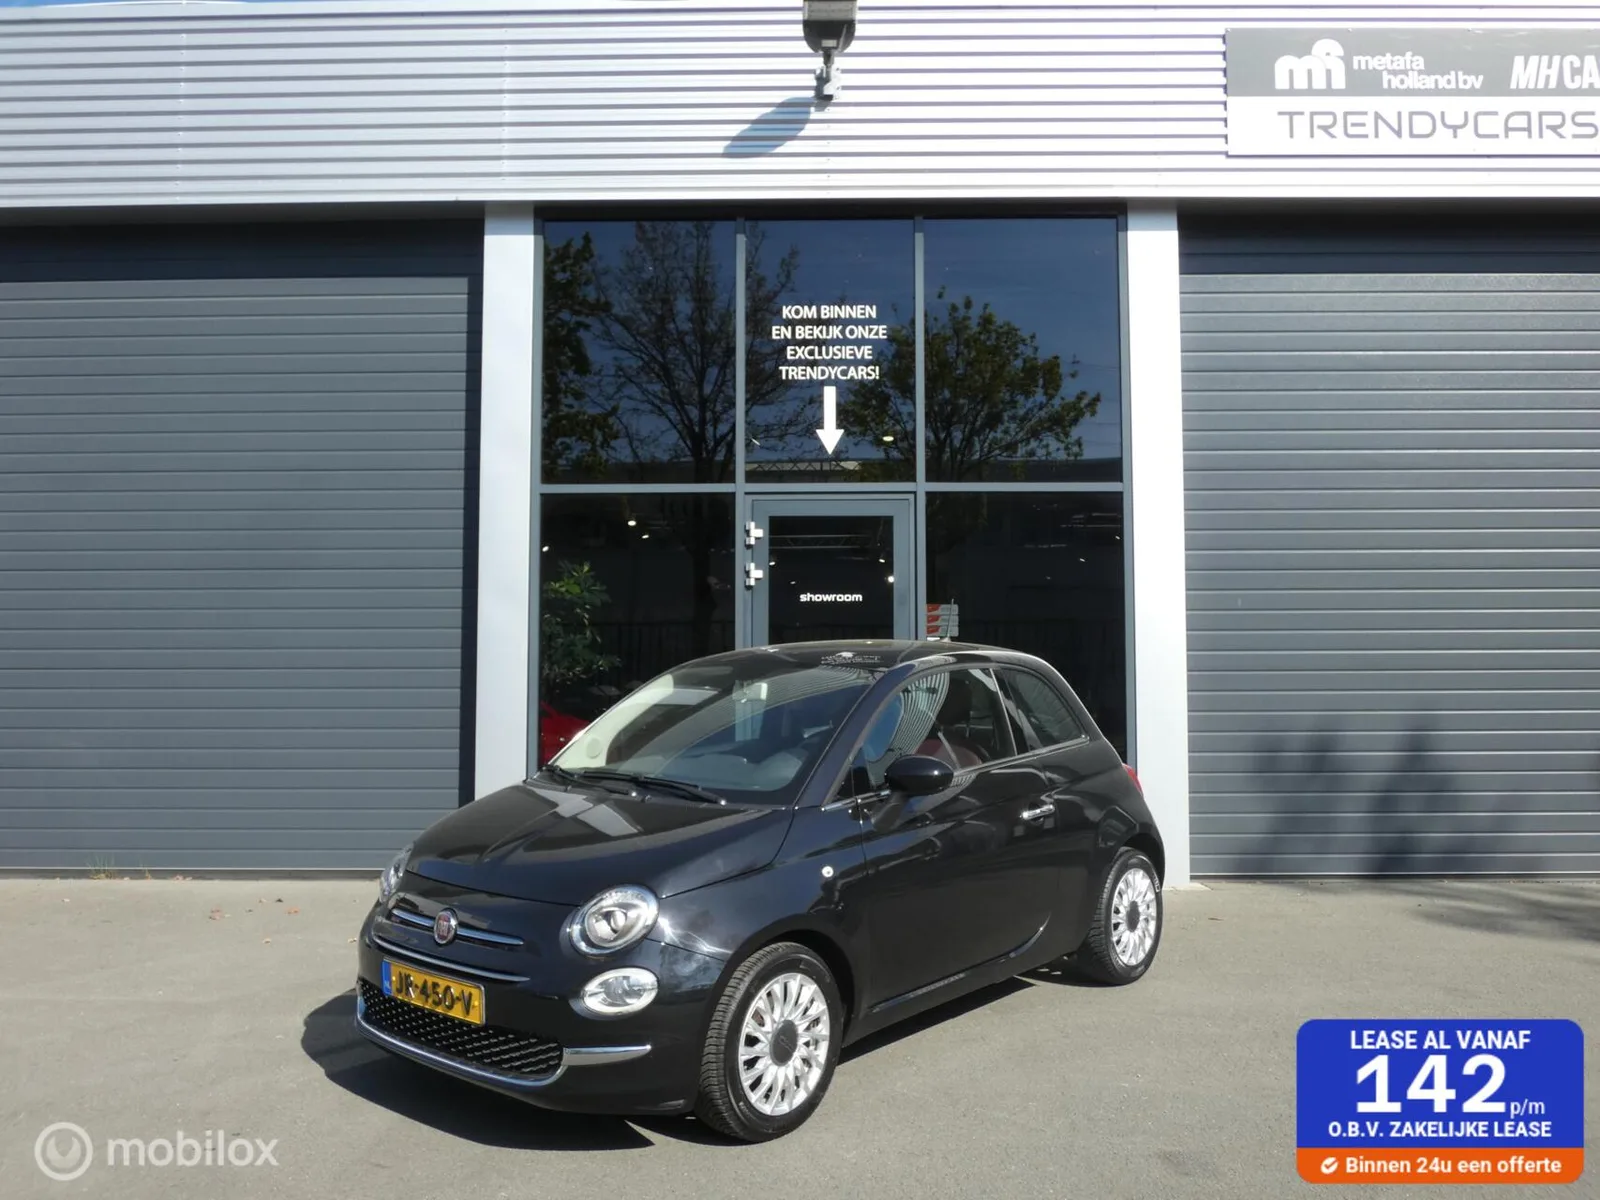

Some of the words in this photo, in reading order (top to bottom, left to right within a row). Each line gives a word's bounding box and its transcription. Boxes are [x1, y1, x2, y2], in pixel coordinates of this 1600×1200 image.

[1352, 51, 1425, 70] metafa
[1277, 110, 1599, 139] TRENDYCARS
[782, 305, 817, 319] KOM
[820, 305, 877, 319] BINNEN
[771, 326, 792, 339] EN
[795, 325, 843, 339] BEKIJK
[845, 325, 887, 339] ONZE
[786, 346, 873, 359] EXCLUSIEVE
[779, 366, 880, 380] TRENDYCARS!
[799, 592, 863, 602] showroom
